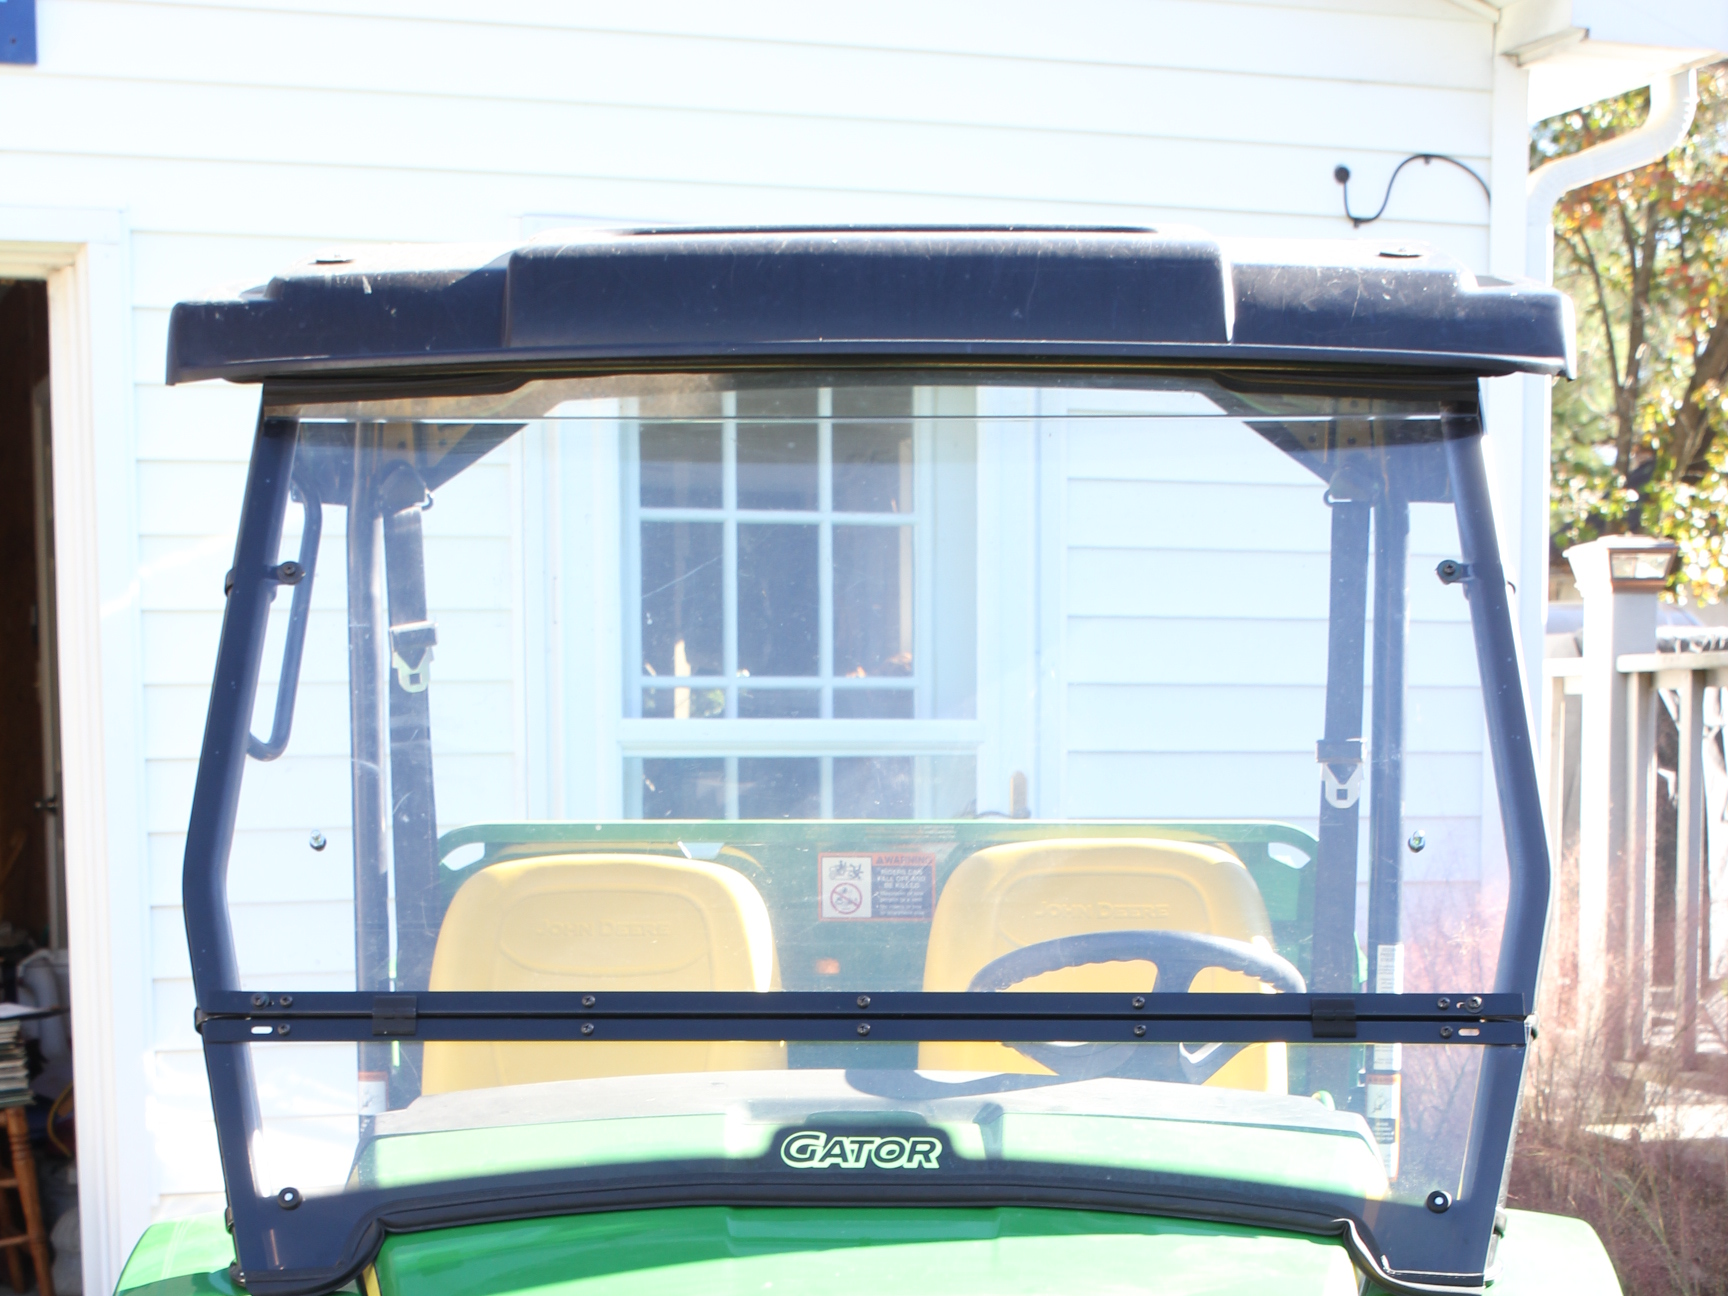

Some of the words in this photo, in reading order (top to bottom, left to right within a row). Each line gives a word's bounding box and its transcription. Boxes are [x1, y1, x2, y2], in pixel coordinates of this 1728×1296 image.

[1034, 901, 1092, 919] JOHN
[1096, 901, 1170, 919] DEERE
[536, 918, 593, 937] JOHN
[598, 918, 672, 937] DEERE
[780, 1131, 943, 1169] GATOR
